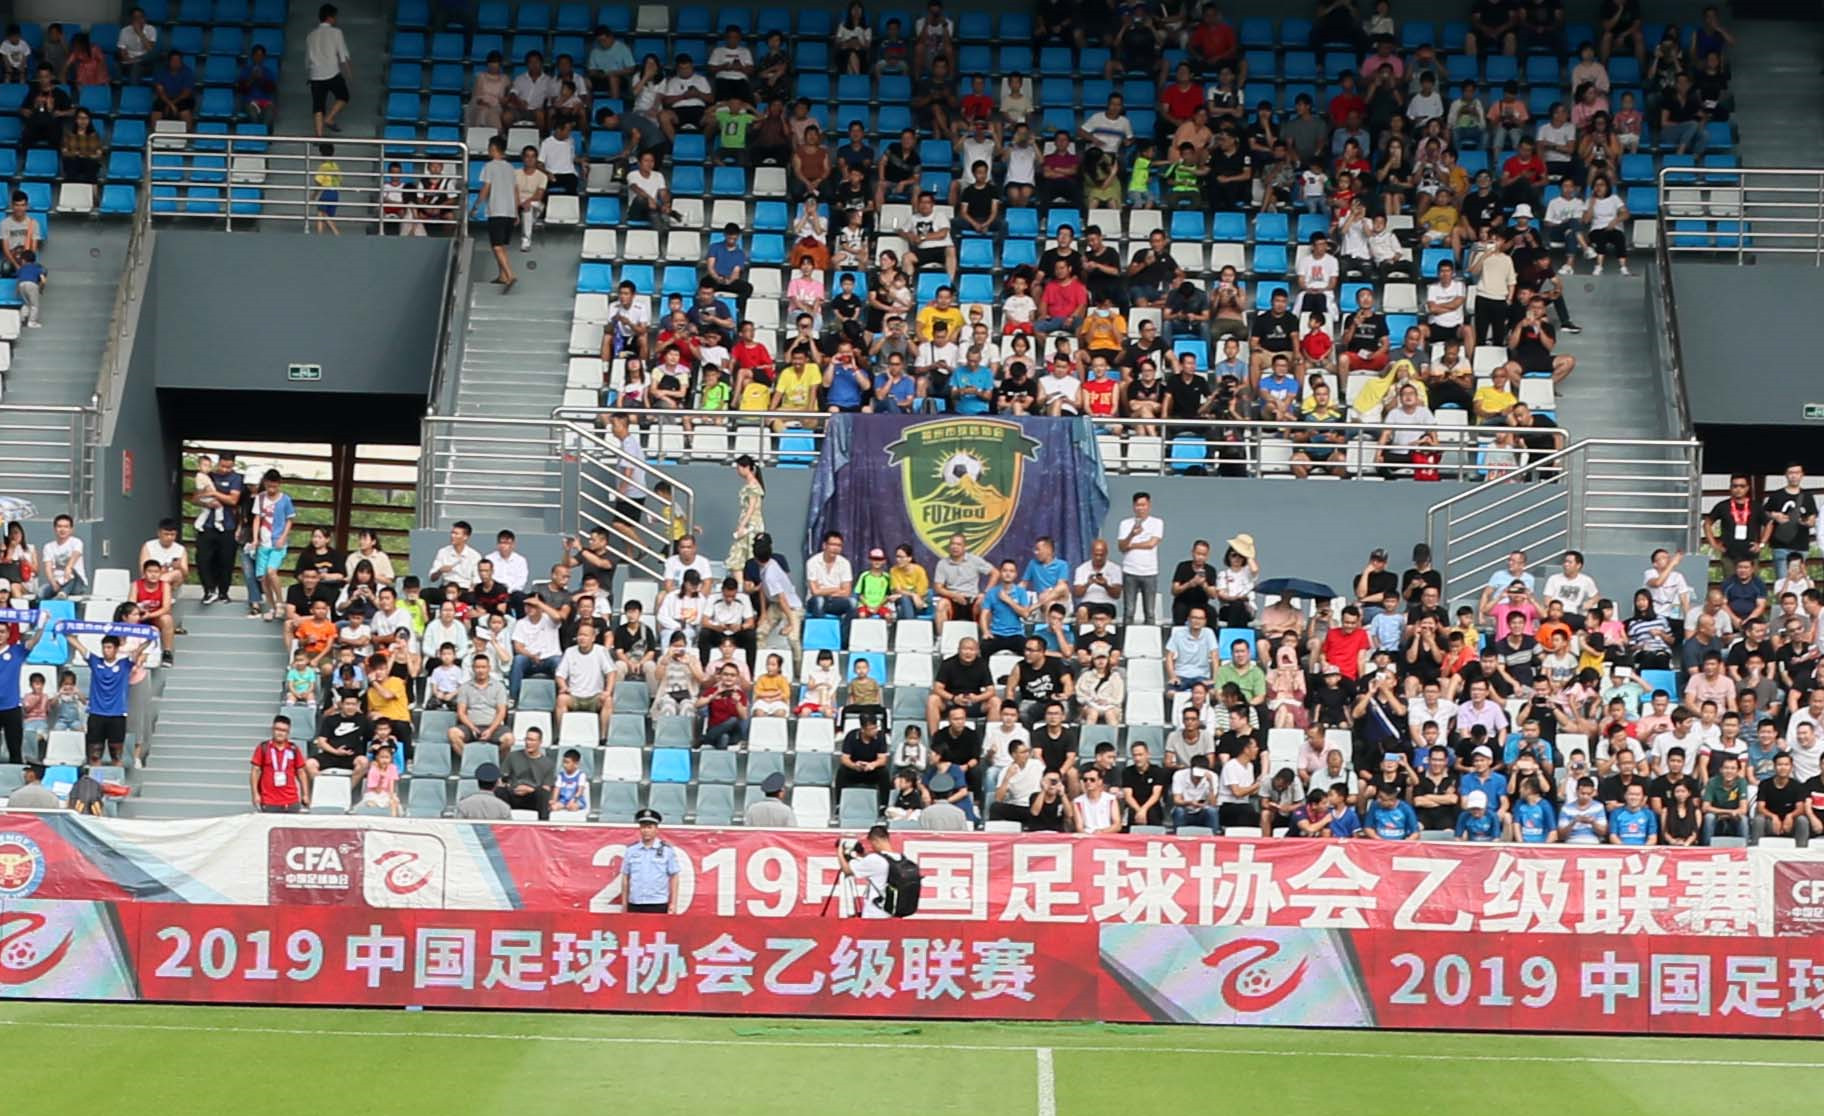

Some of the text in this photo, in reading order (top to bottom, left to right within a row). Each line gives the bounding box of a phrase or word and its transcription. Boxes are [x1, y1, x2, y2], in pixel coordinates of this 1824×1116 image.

[922, 503, 986, 525] FUZHOU
[285, 846, 344, 872] CFA
[156, 925, 1037, 1003] 2019 中国足球协会乙级联赛
[1390, 952, 1558, 1008] 2019
